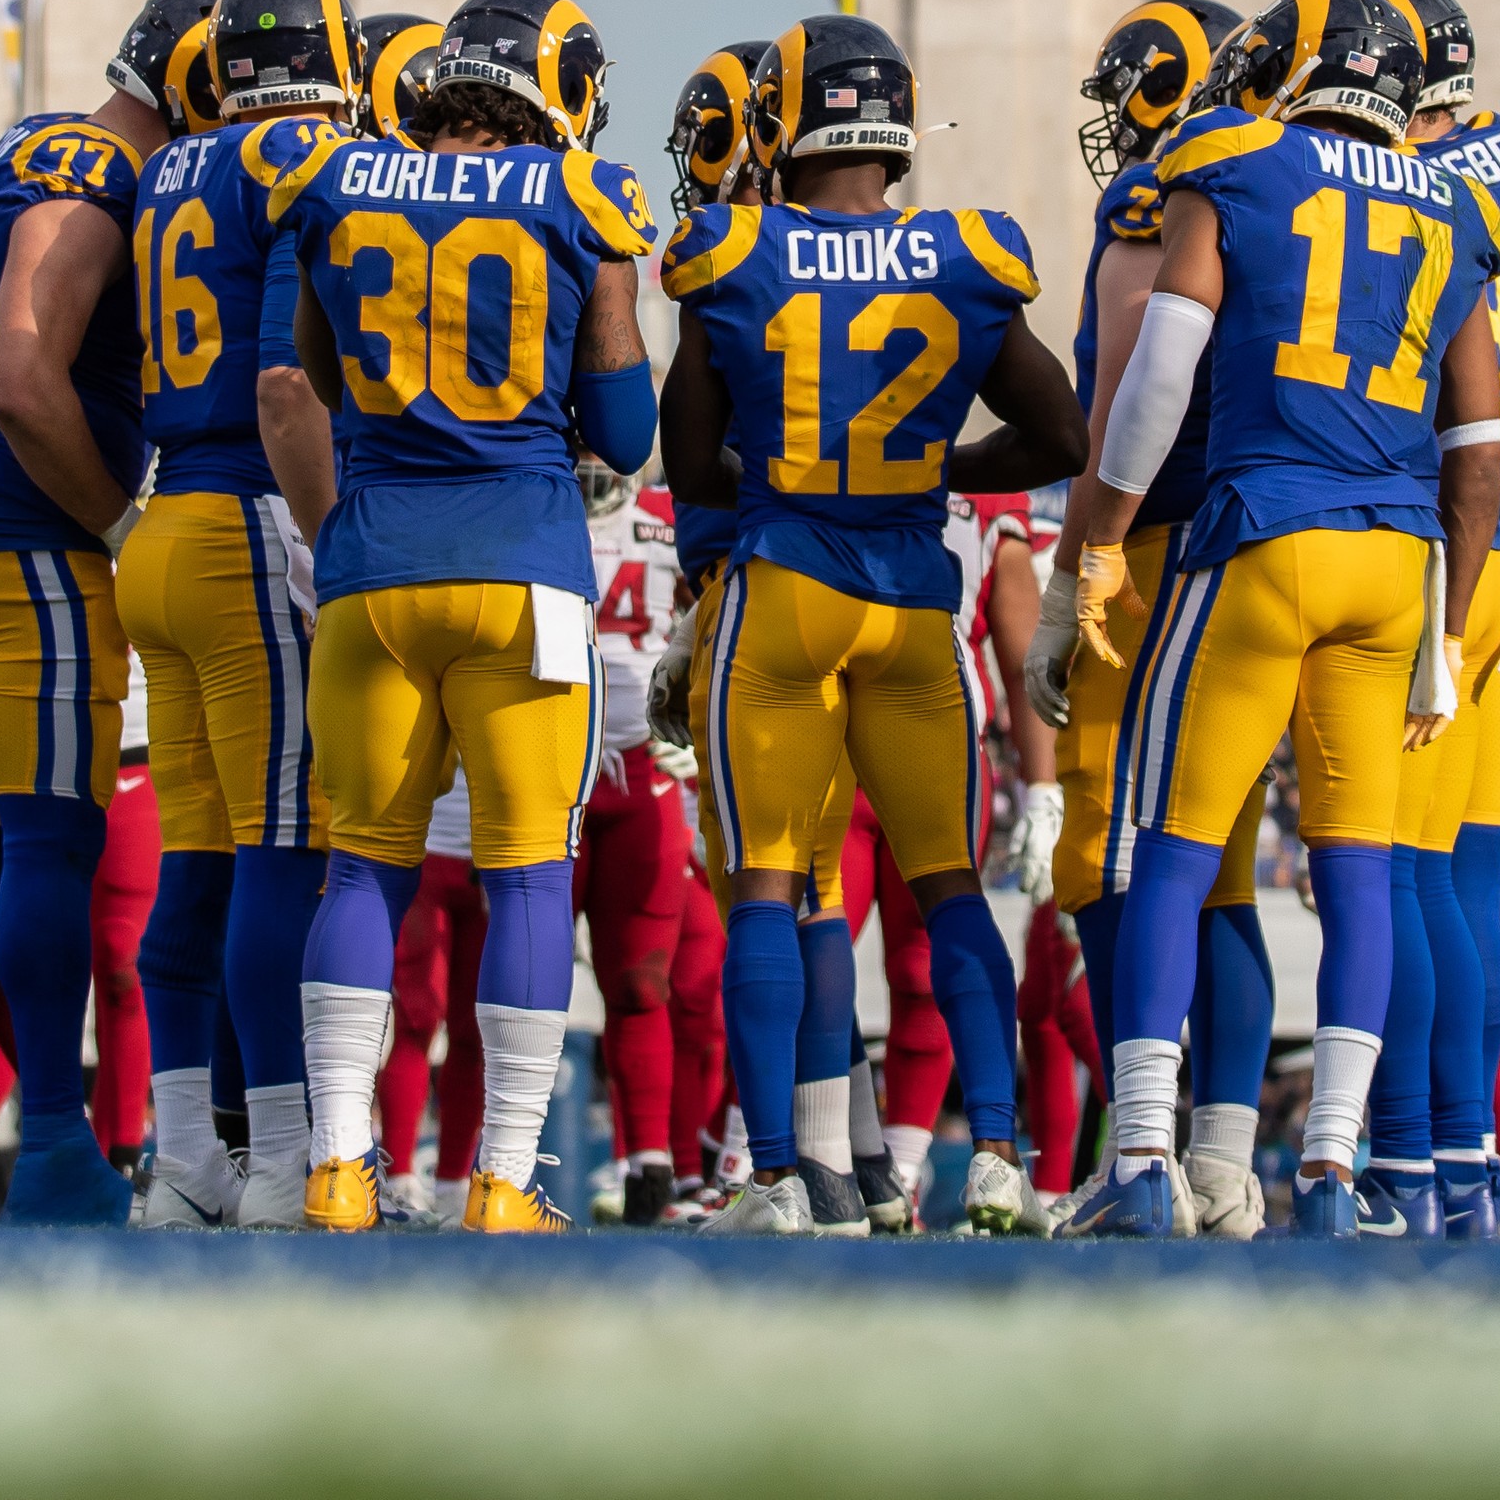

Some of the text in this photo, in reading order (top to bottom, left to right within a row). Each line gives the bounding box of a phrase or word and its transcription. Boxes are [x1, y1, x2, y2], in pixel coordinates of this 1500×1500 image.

[236, 88, 321, 110] LOS ANGELES
[436, 61, 512, 87] LOS ANGELES
[1337, 90, 1365, 106] LOS
[49, 138, 116, 187] 77
[154, 136, 218, 196] GOFF
[826, 130, 909, 148] LOS ANGELES
[340, 150, 551, 206] GURLEY II
[1309, 136, 1453, 207] WOODS
[787, 228, 939, 282] COOKS
[133, 196, 224, 394] 16
[328, 210, 548, 423] 30
[1274, 187, 1453, 414] 17
[765, 292, 960, 496] 12
[977, 1158, 1010, 1196] NIKE
